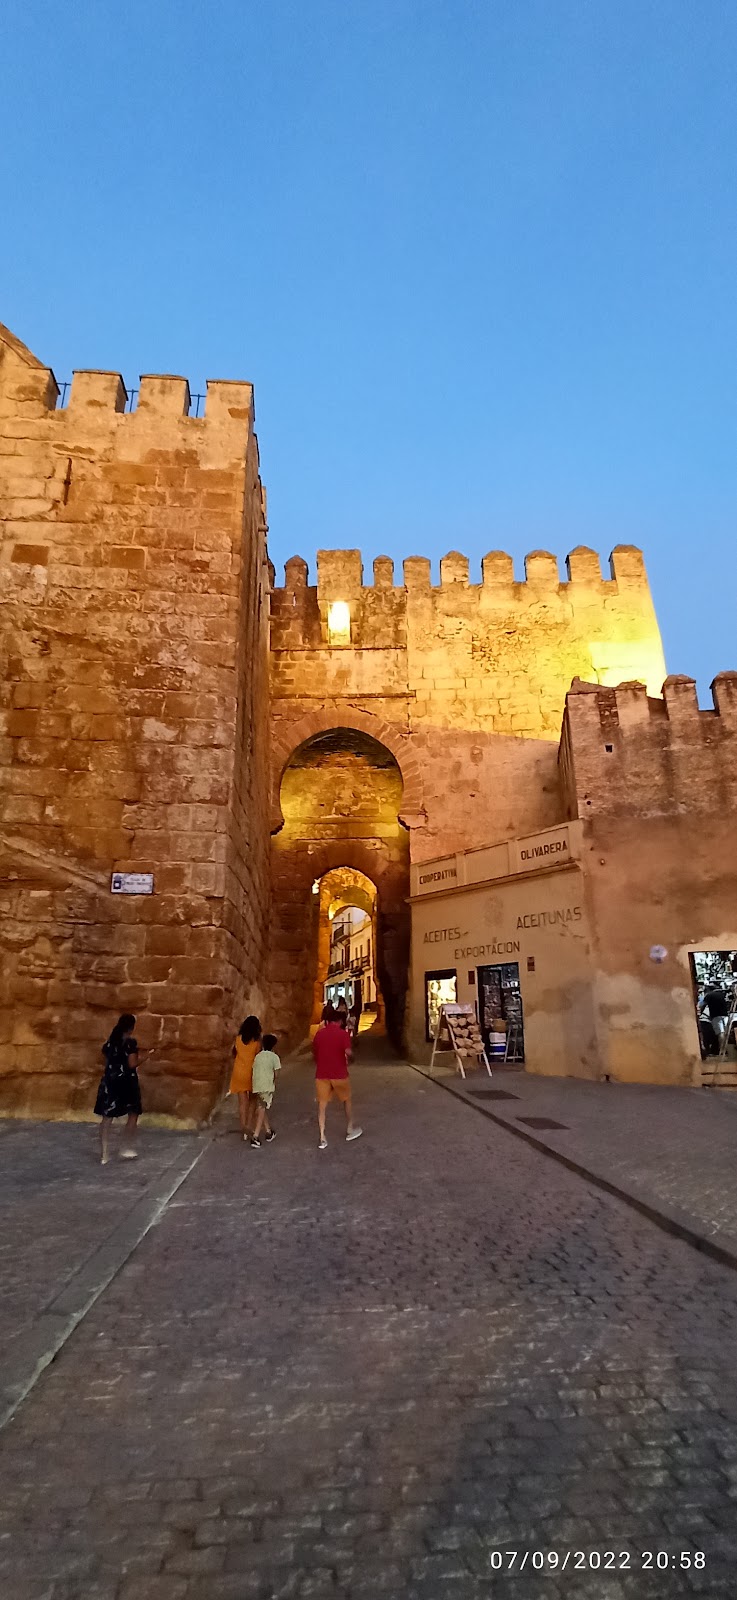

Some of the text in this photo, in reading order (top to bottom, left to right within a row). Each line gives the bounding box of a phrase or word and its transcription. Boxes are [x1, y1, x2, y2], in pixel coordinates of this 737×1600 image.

[419, 840, 568, 885] COOPERATIVA OLIVARERA
[423, 906, 582, 944] ACEITES ACEITUNAS
[454, 941, 520, 960] EXPORTACION
